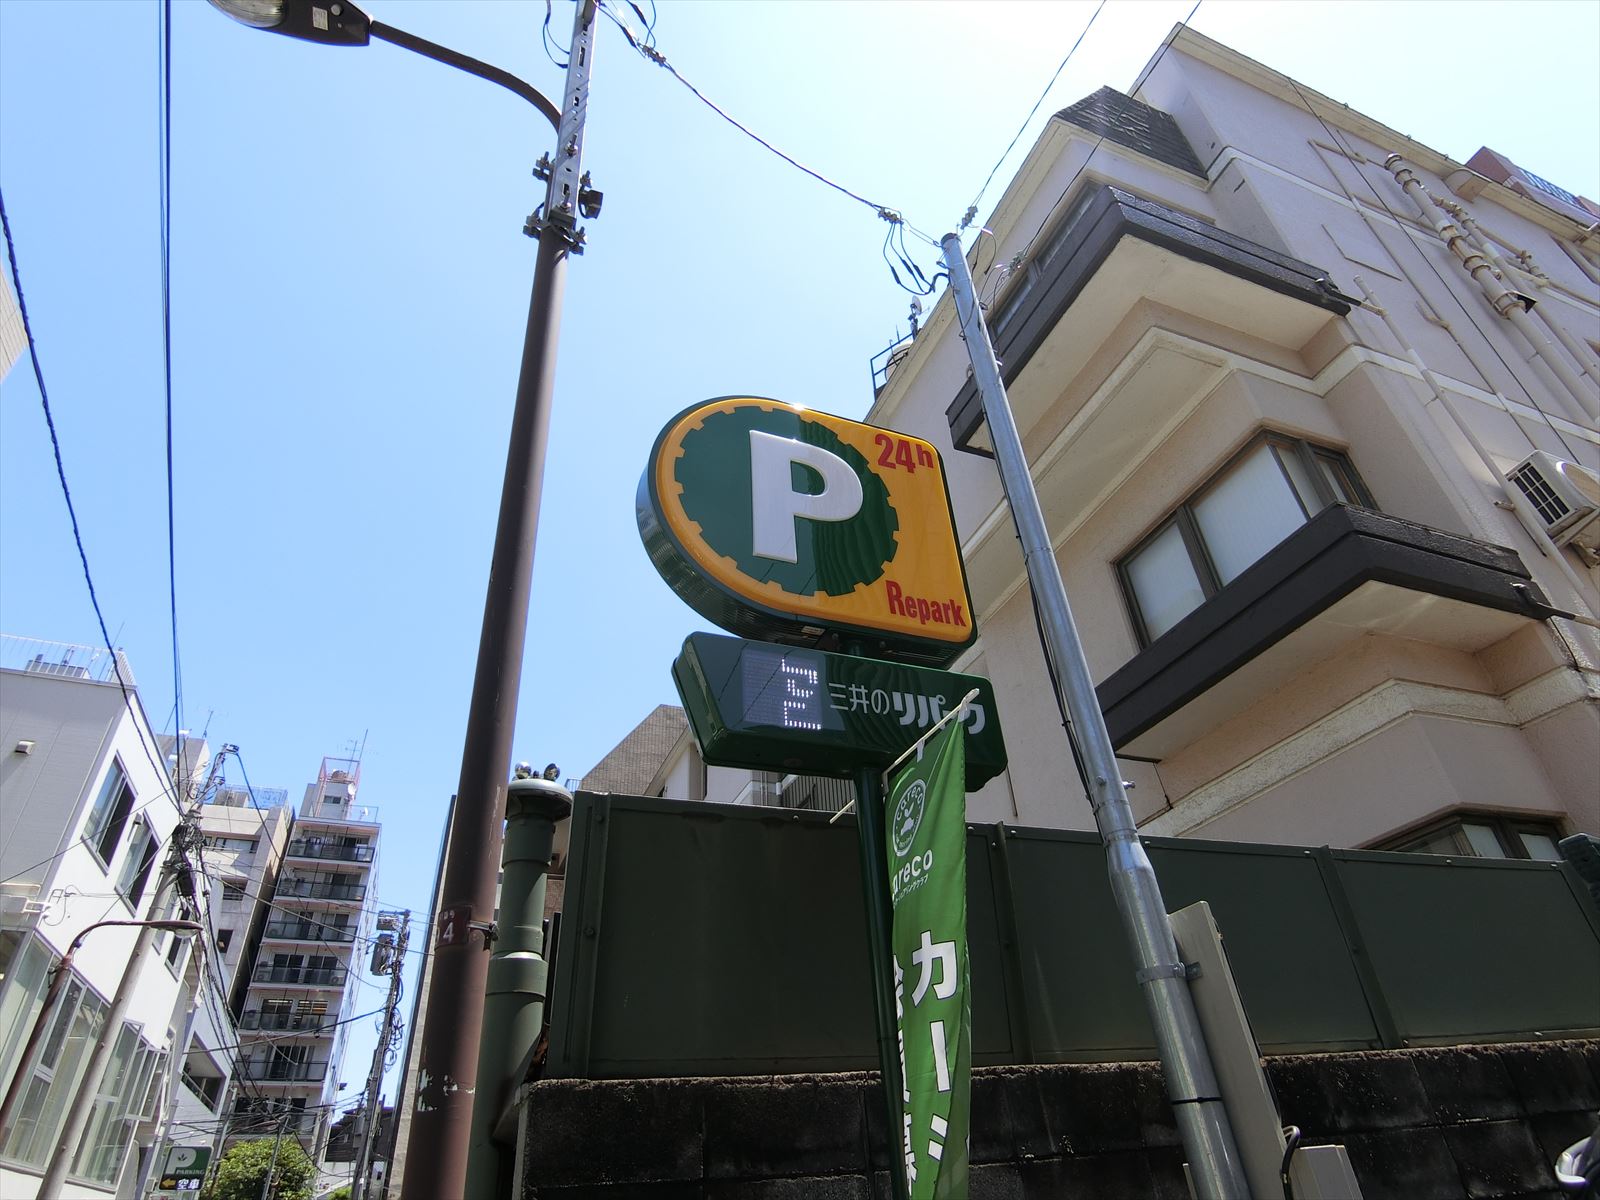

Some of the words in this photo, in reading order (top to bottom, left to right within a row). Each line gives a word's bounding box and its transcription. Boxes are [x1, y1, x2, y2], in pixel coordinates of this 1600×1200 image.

[874, 433, 934, 473] 24h
[749, 429, 863, 563] P
[885, 579, 967, 627] Repark
[892, 849, 933, 901] areco
[177, 1178, 200, 1190] 空車
